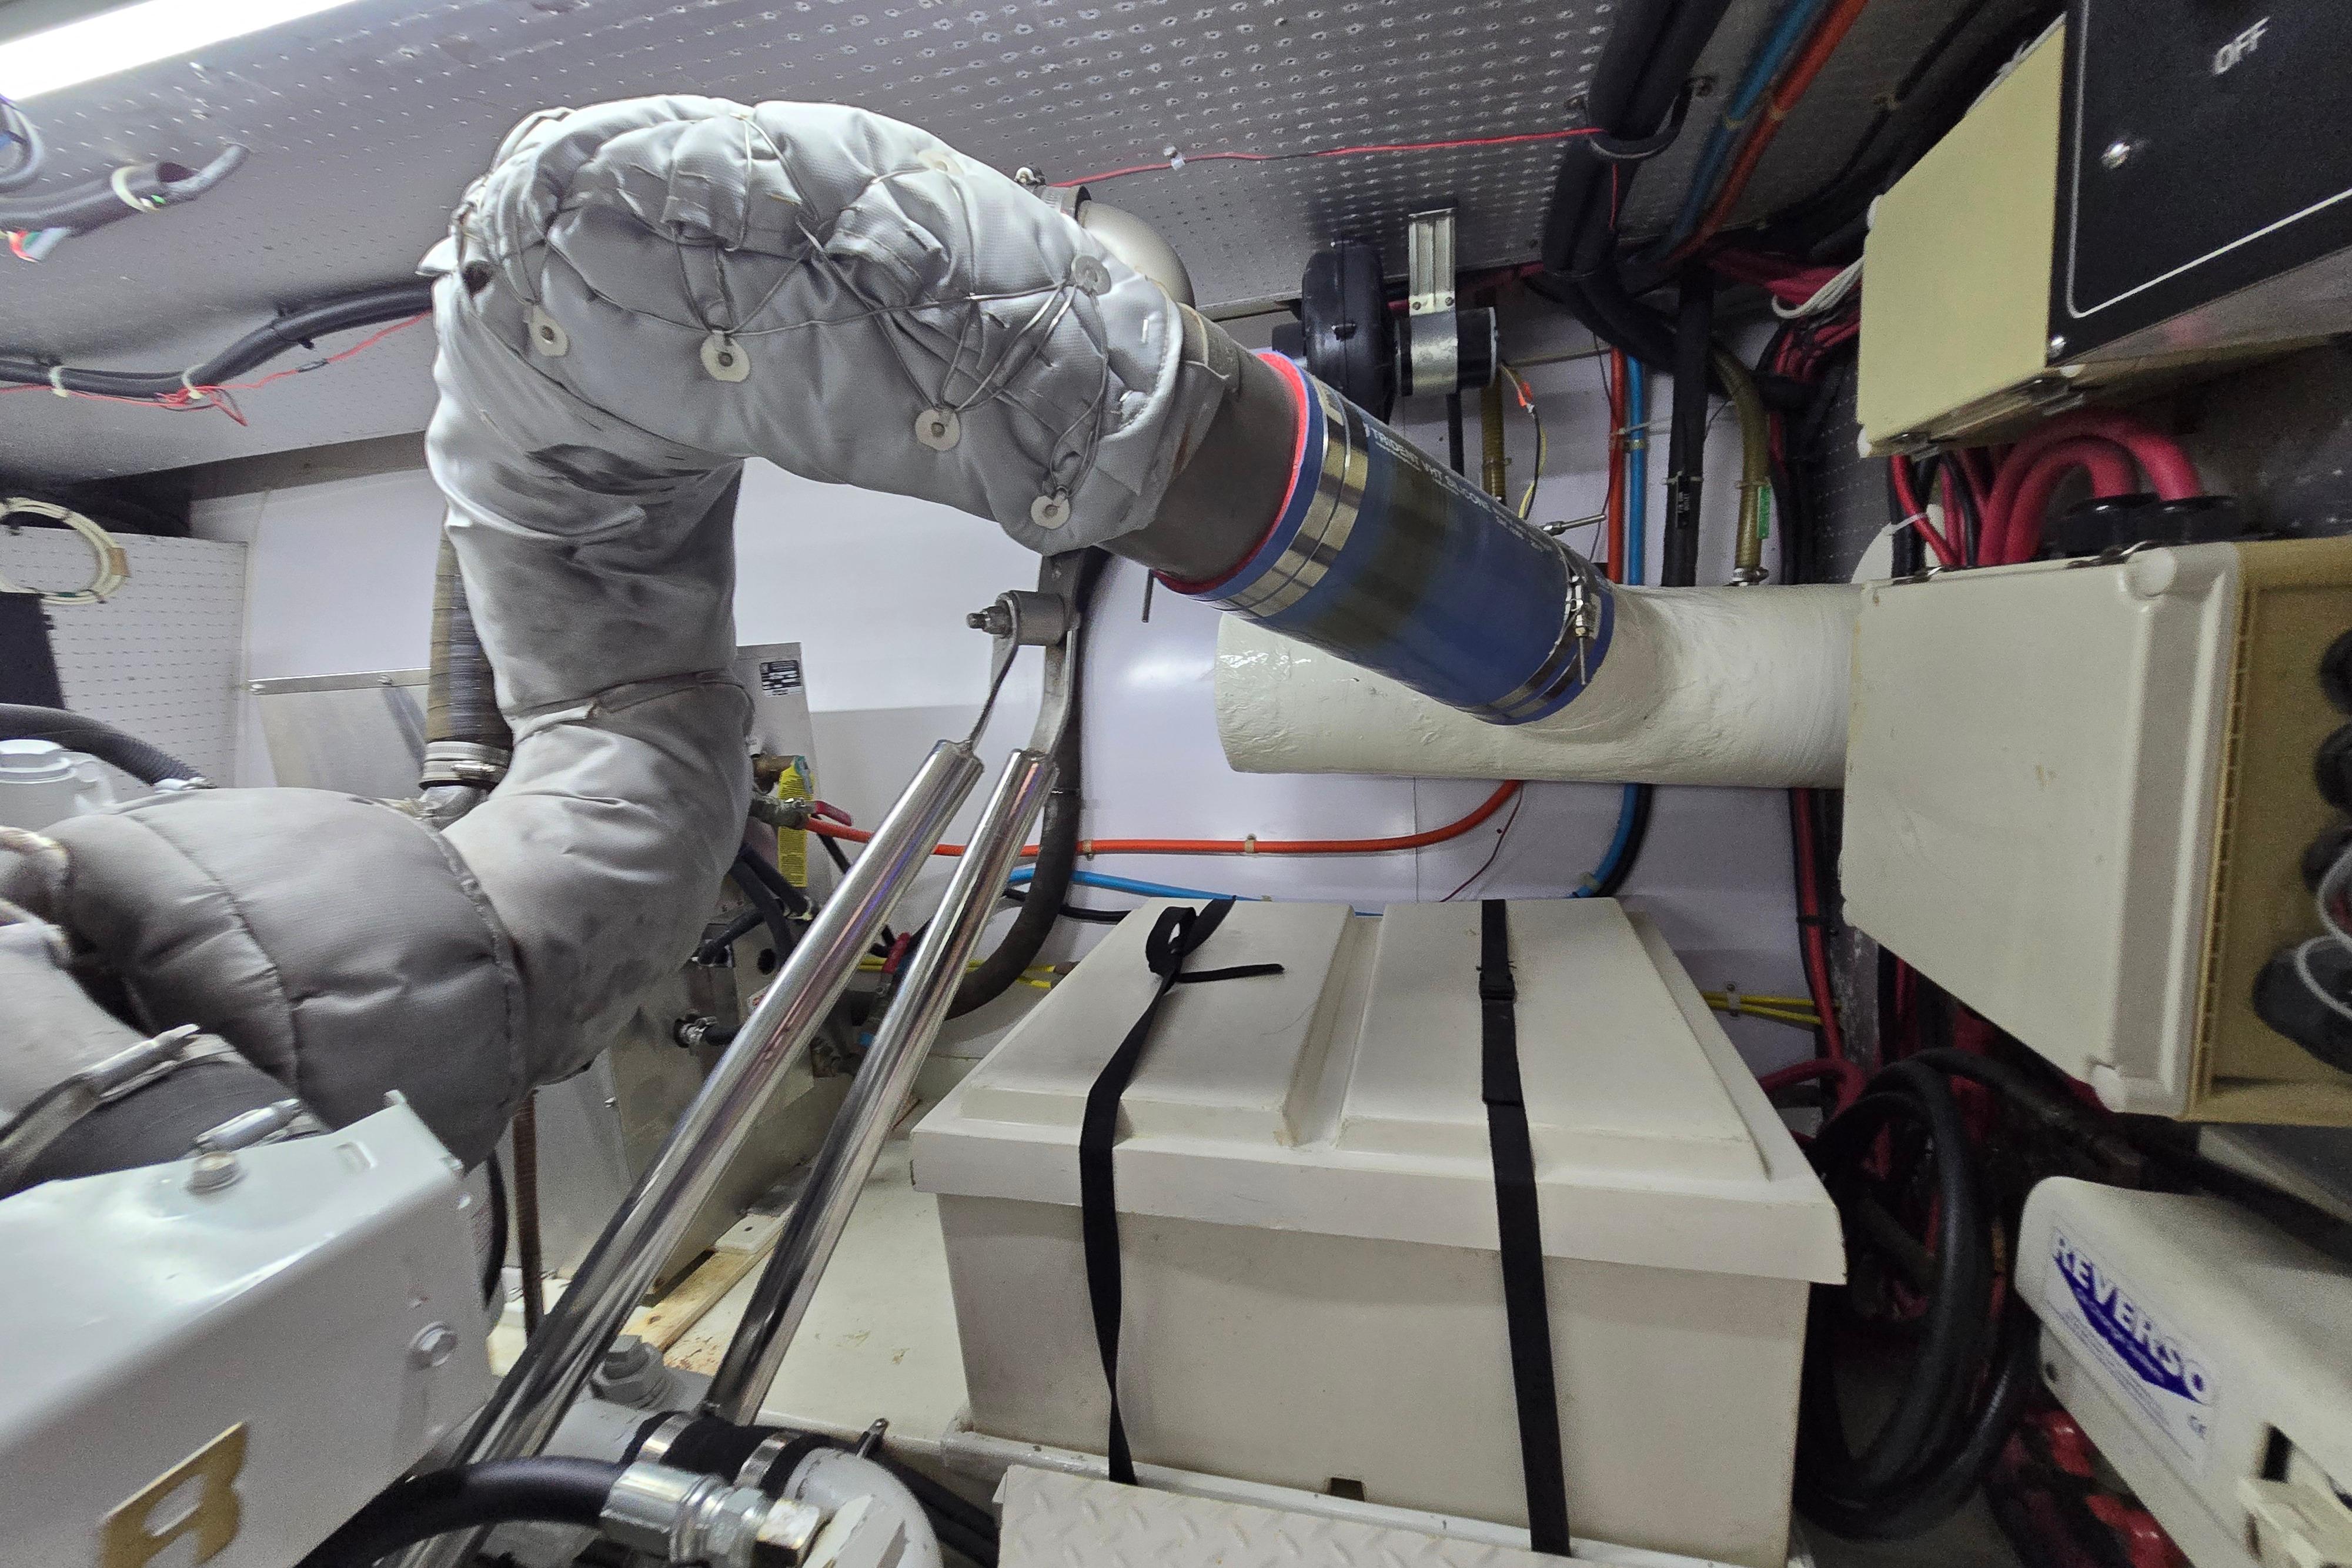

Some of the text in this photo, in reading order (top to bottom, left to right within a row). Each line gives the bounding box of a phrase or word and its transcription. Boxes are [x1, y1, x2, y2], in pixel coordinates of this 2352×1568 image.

[2213, 16, 2270, 75] OFF
[1371, 427, 1419, 465] TRIDENT
[2051, 1233, 2210, 1403] REVERSO
